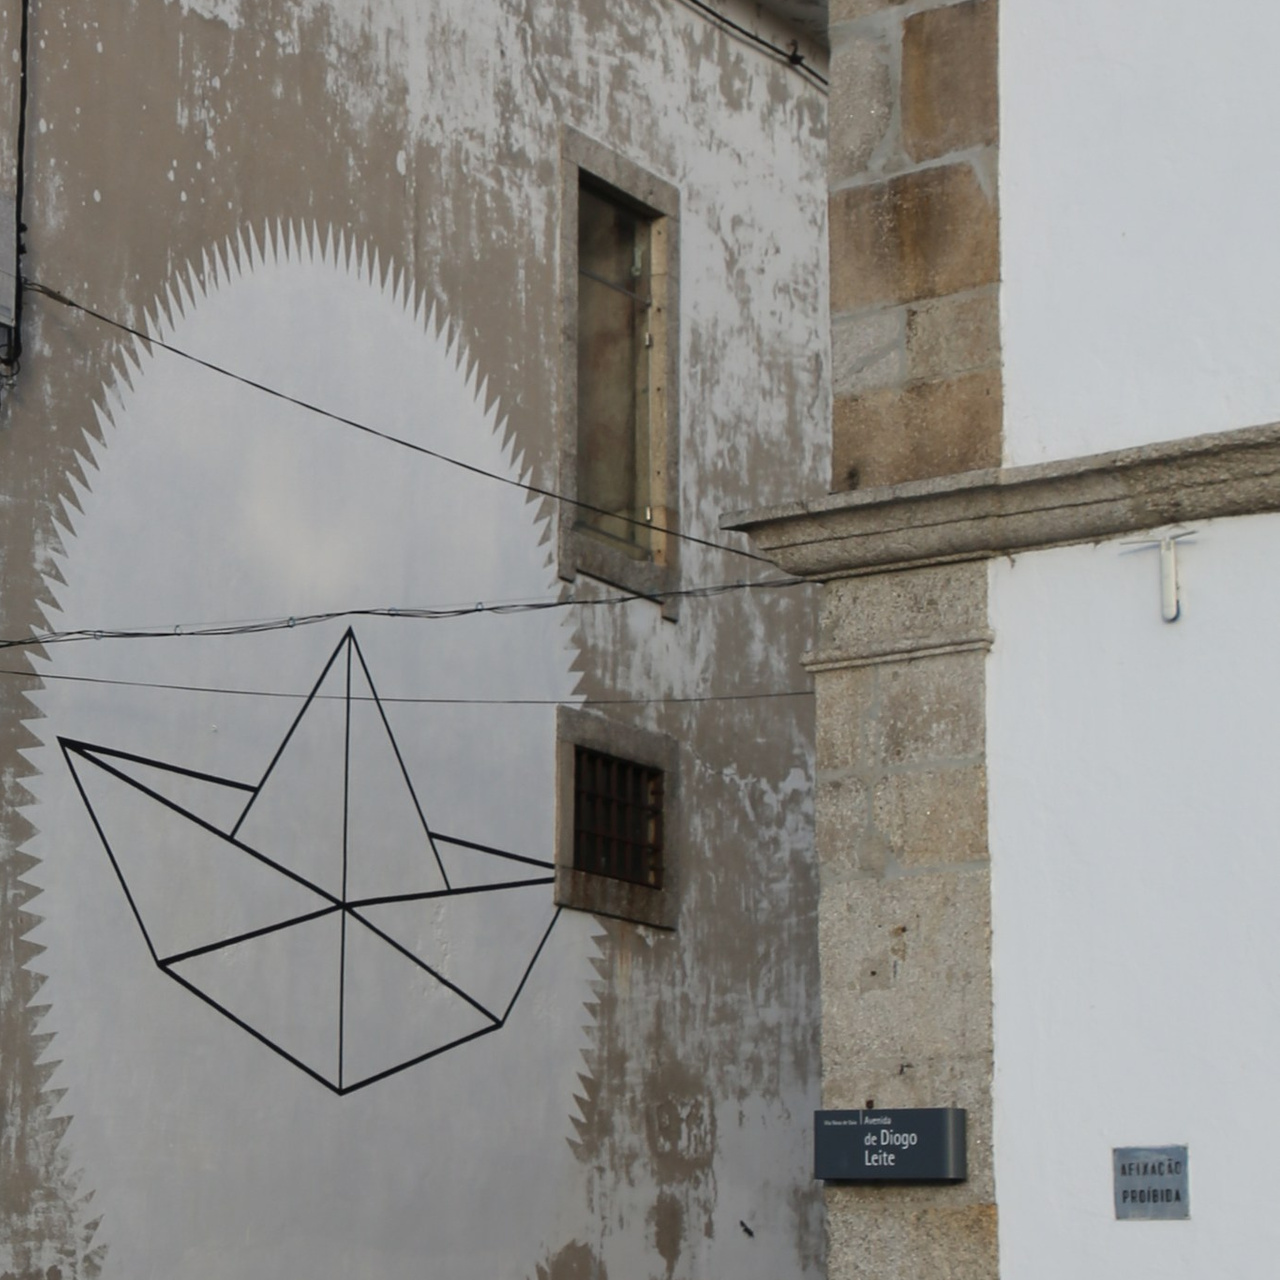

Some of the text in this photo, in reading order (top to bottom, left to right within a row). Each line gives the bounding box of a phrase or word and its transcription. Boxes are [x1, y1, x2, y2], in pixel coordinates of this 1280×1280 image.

[864, 1116, 892, 1125] Avenida
[864, 1129, 918, 1150] de Diogo
[864, 1150, 896, 1166] Leite
